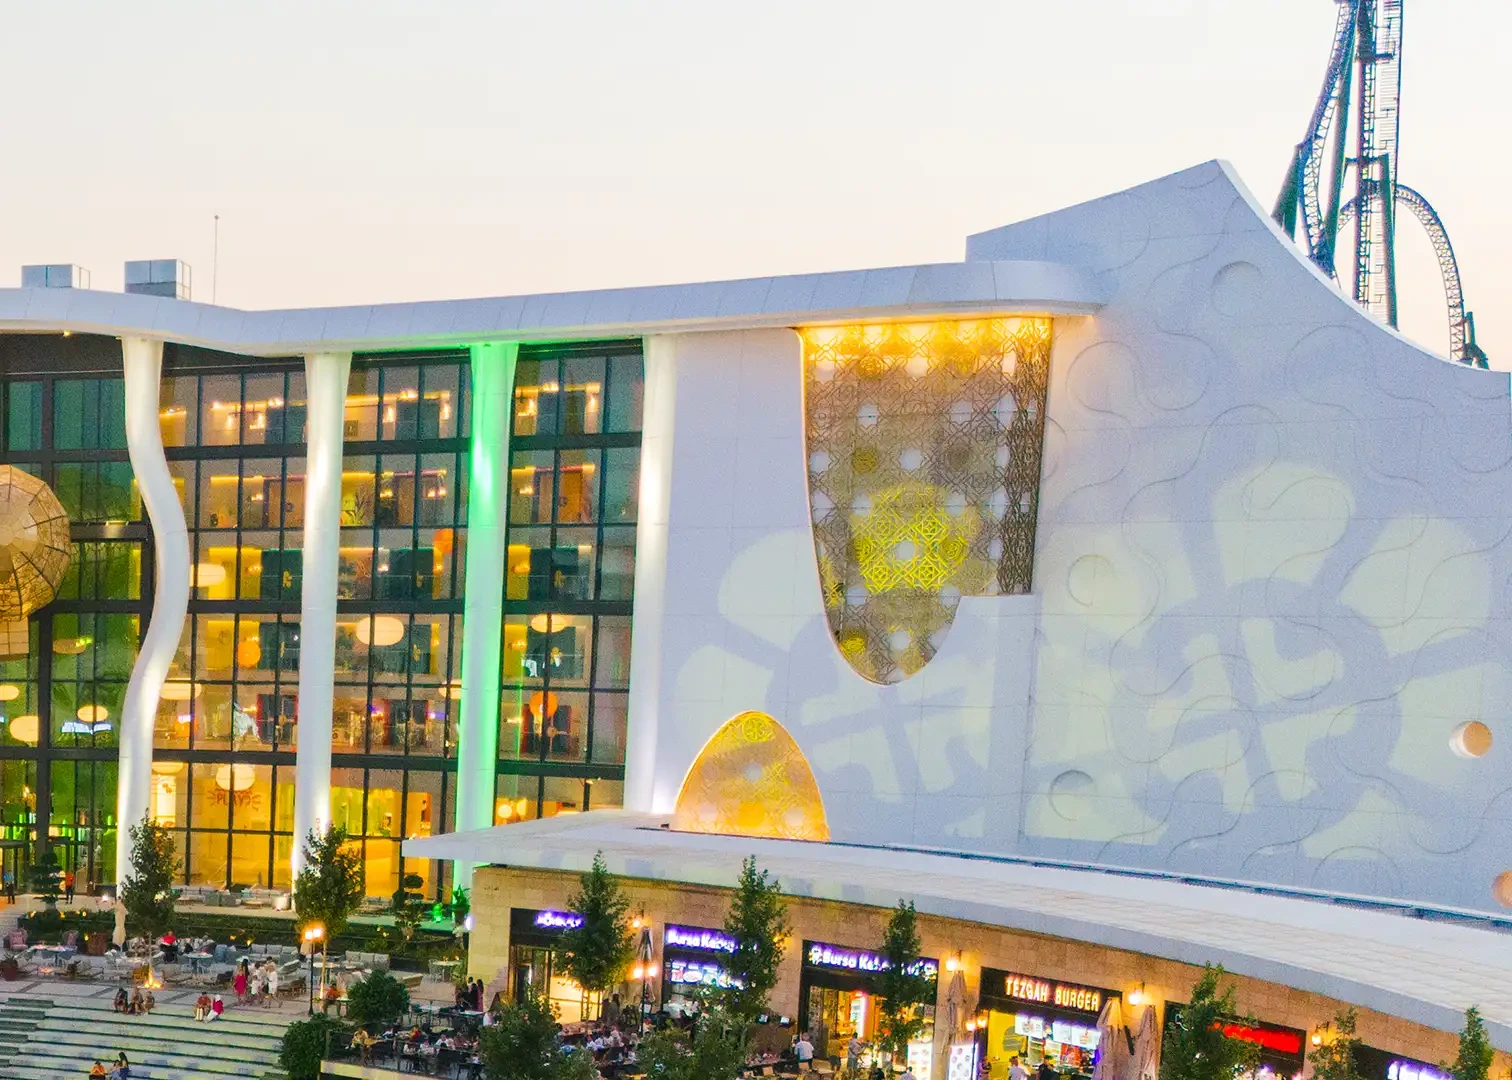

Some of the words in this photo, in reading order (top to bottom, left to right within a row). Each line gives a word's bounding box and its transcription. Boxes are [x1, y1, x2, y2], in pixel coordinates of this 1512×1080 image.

[667, 928, 700, 947] Bursa
[822, 950, 857, 969] Bursa
[1054, 985, 1100, 1011] BURGER
